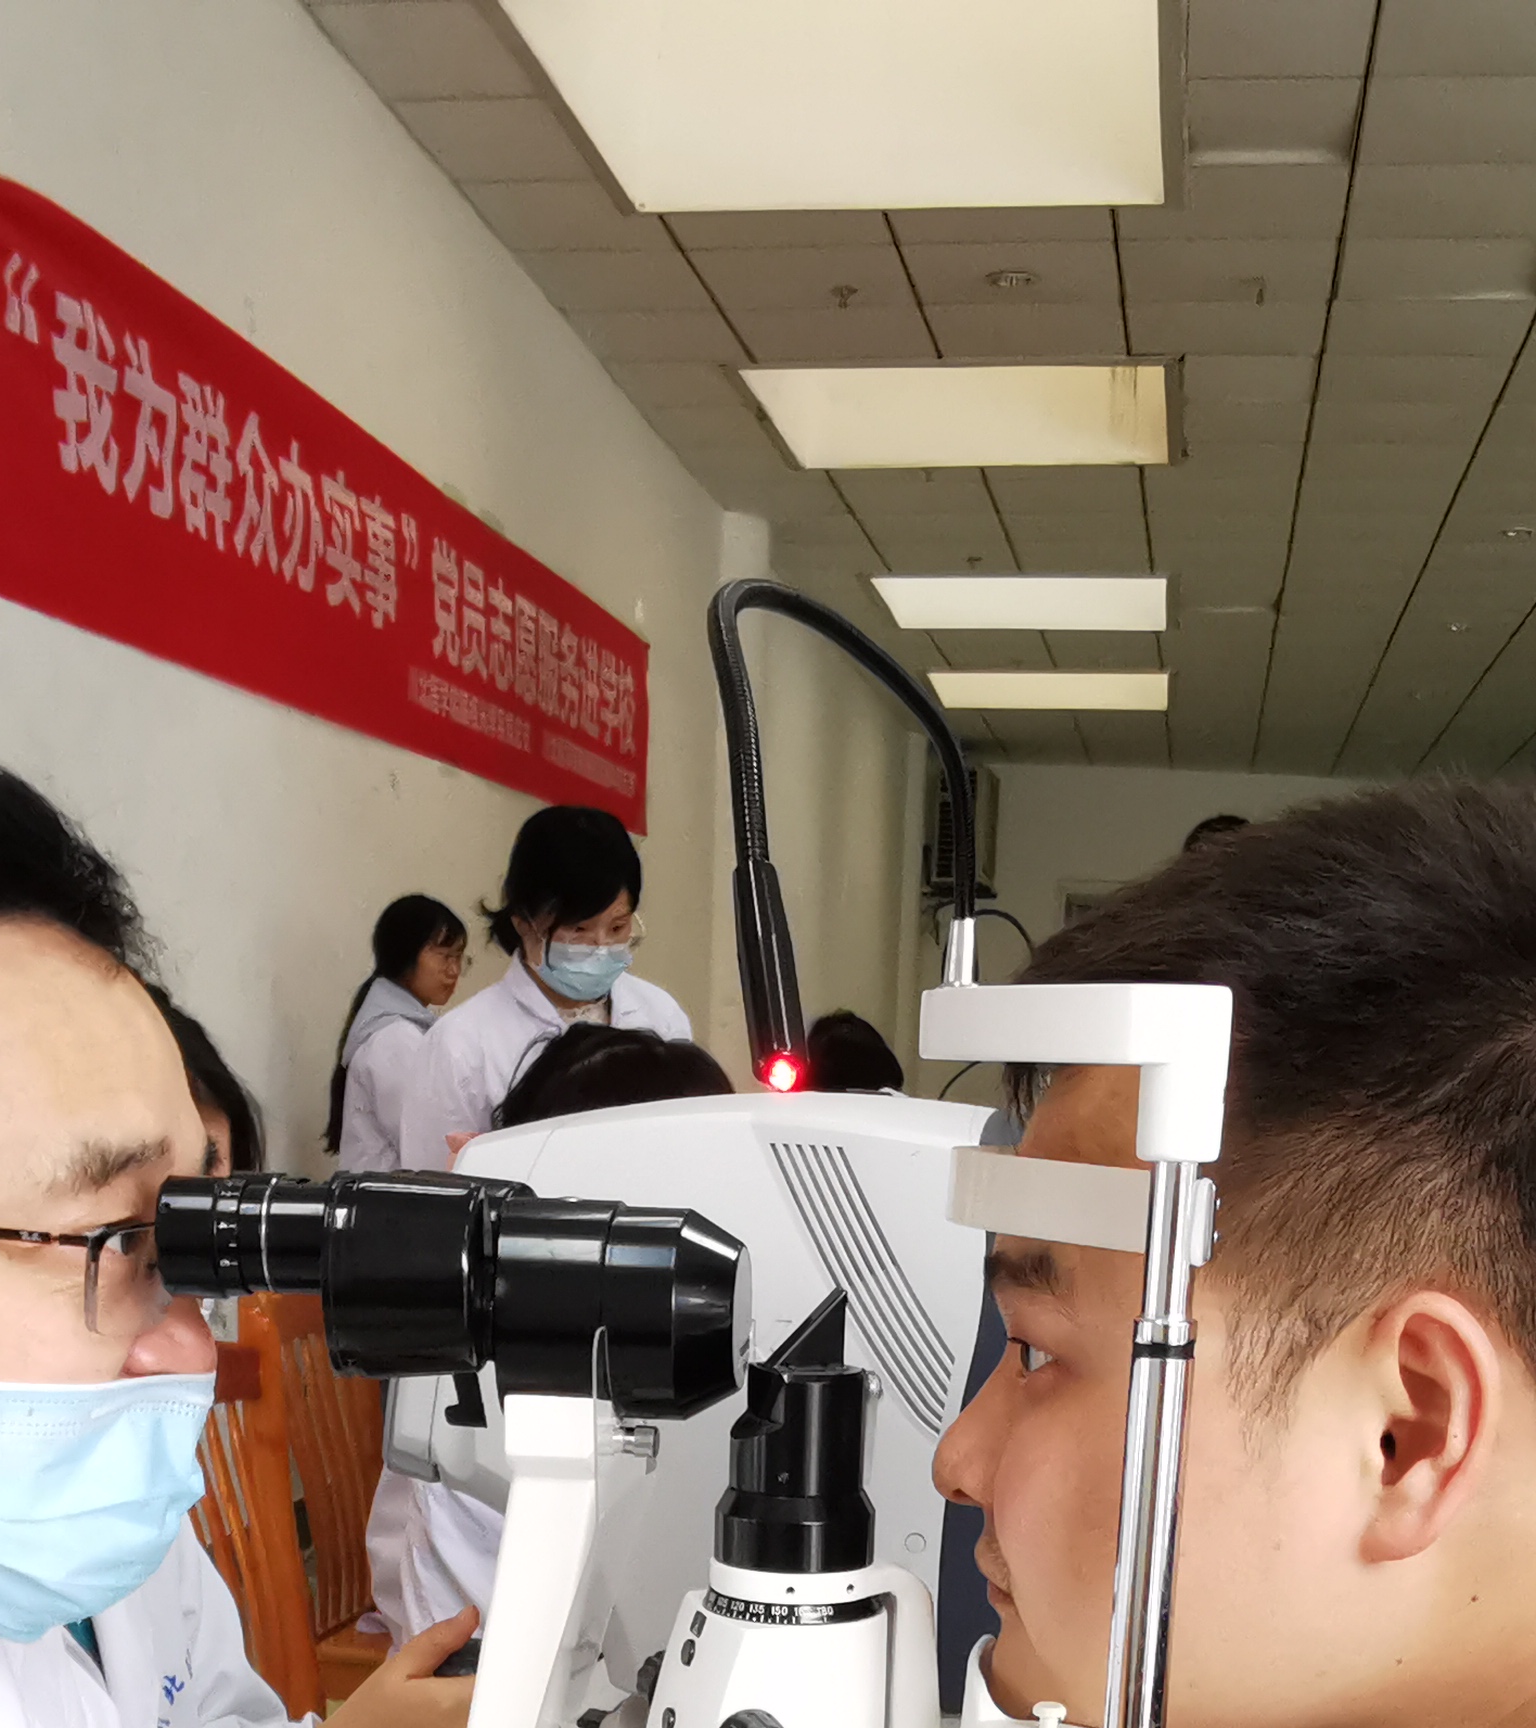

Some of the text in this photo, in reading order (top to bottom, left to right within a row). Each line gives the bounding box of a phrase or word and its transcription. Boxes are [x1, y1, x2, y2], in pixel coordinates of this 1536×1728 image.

[730, 1600, 745, 1611] 120
[749, 1603, 765, 1614] 135
[770, 1606, 789, 1616] 150
